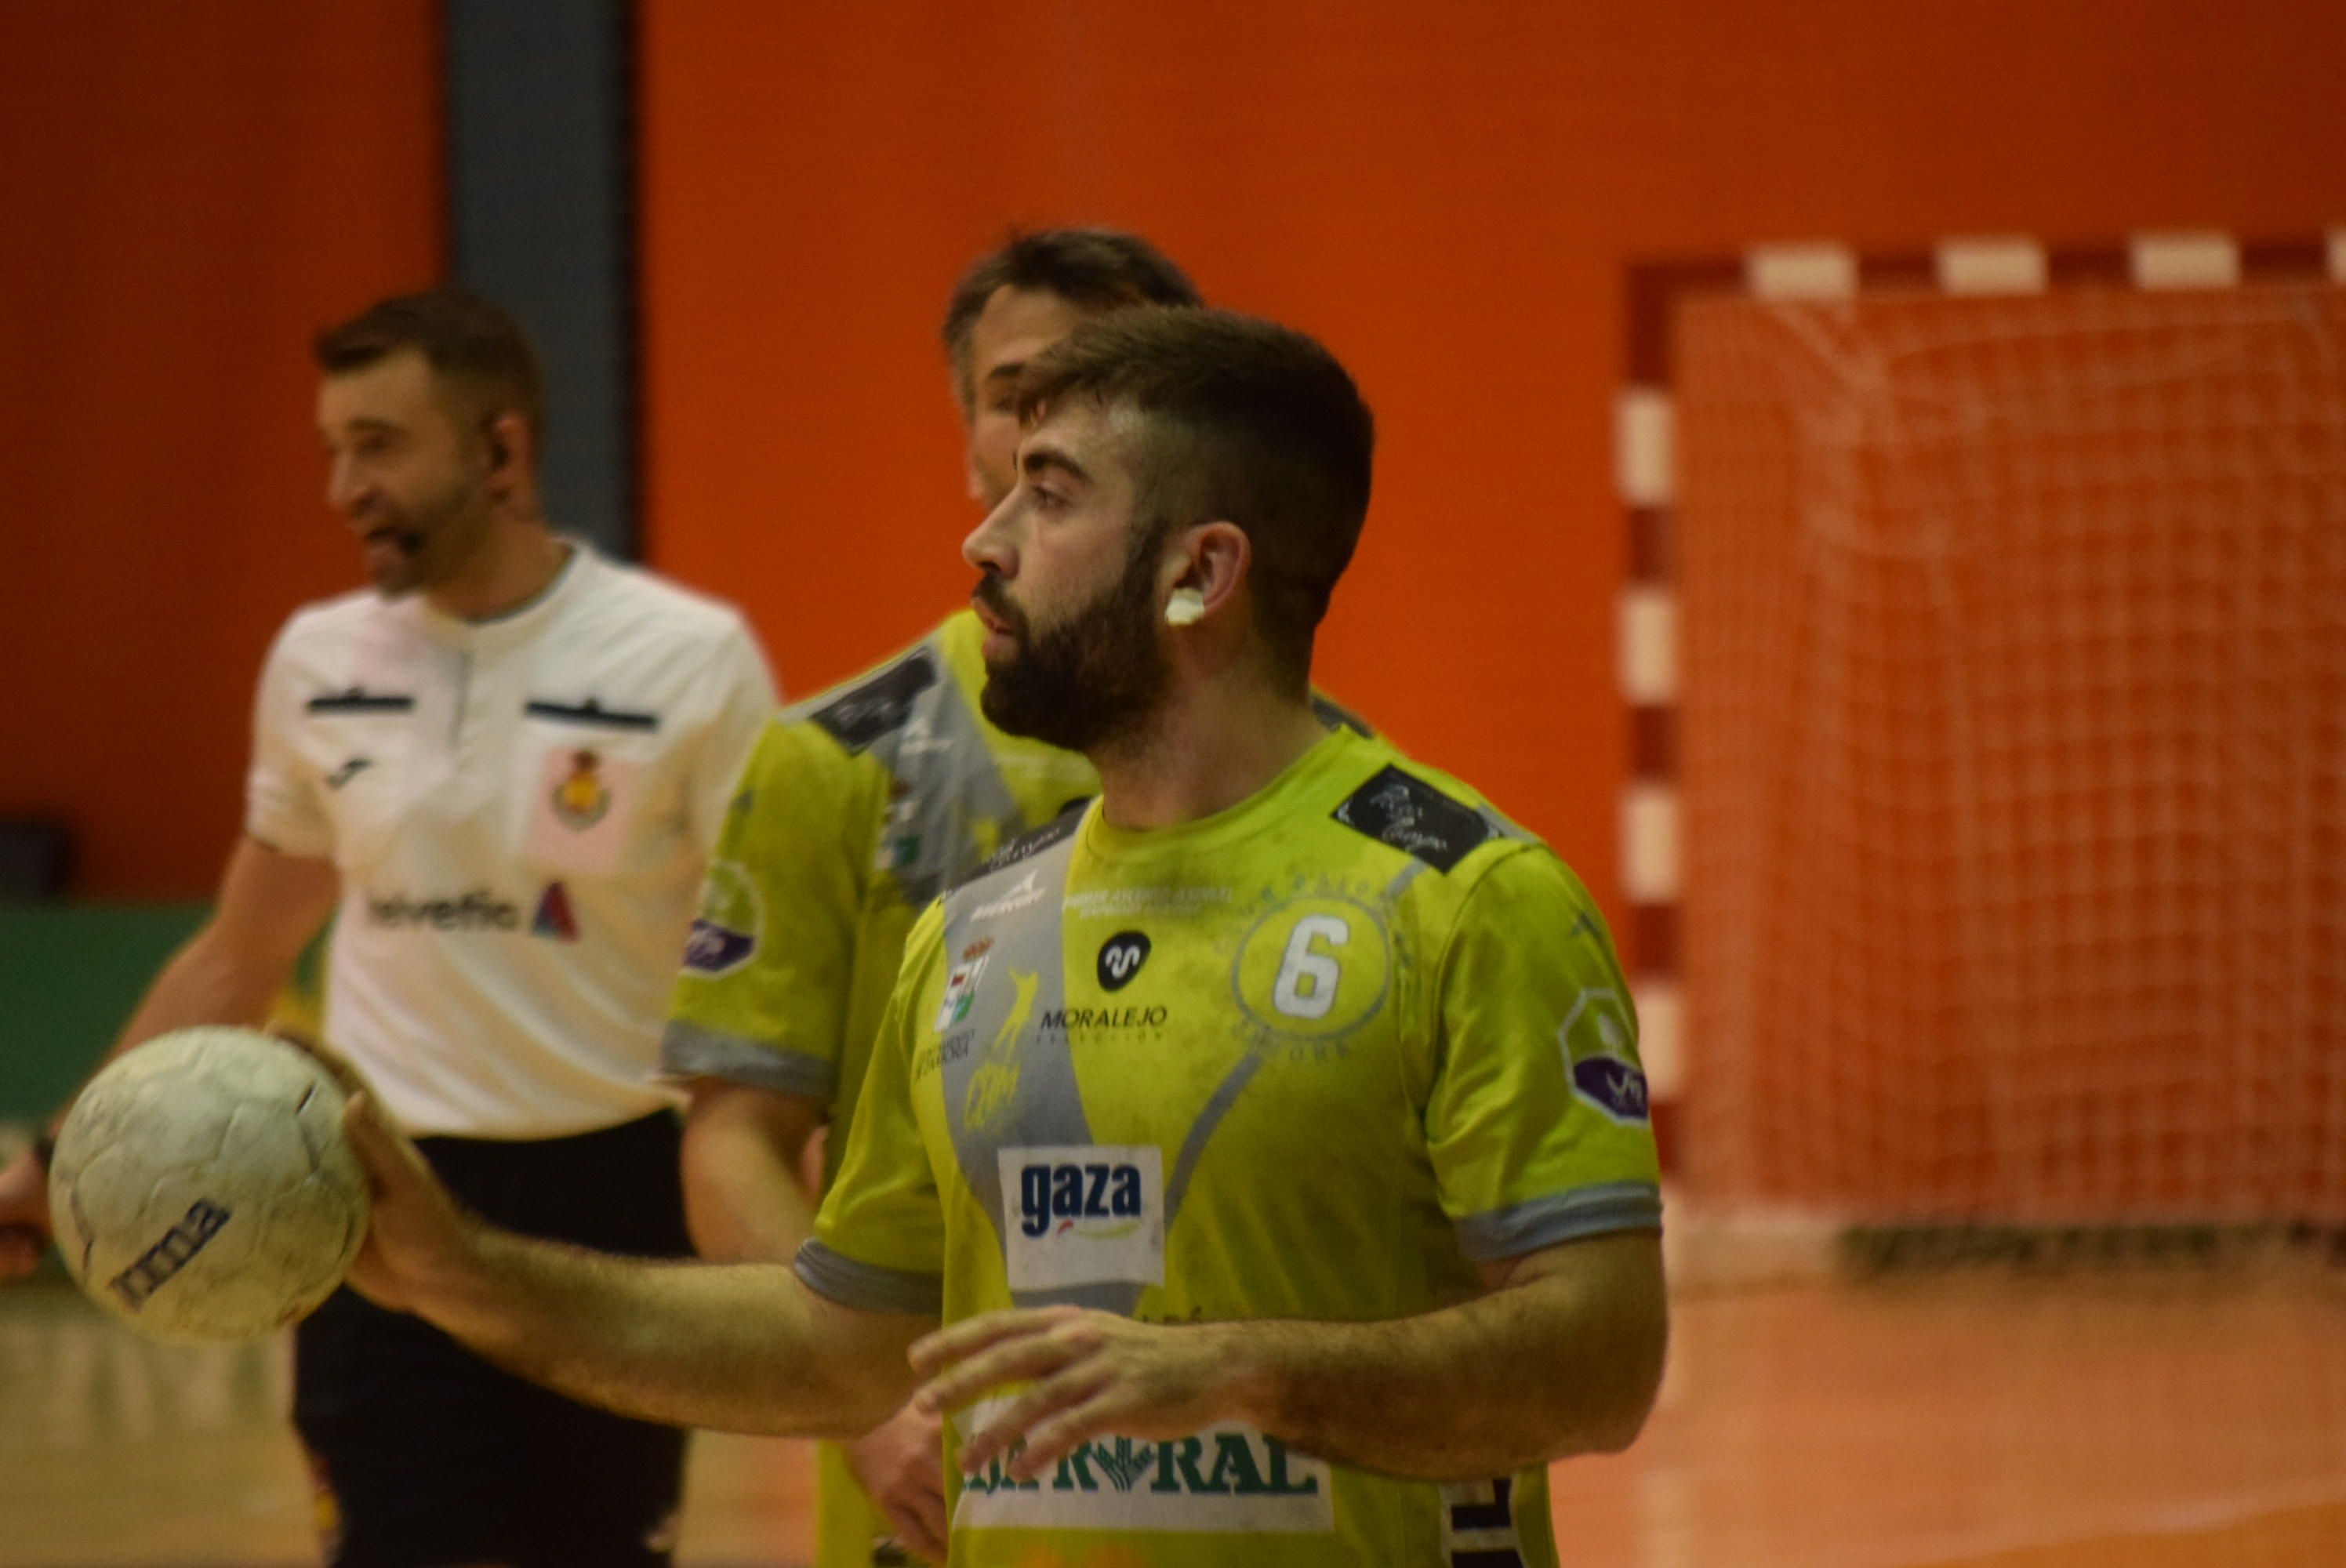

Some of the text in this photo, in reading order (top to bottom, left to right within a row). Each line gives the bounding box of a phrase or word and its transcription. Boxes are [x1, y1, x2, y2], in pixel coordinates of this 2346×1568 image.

[1273, 914, 1349, 1019] 6
[1040, 1004, 1168, 1029] MORALEJO
[1020, 1163, 1142, 1238] gaza
